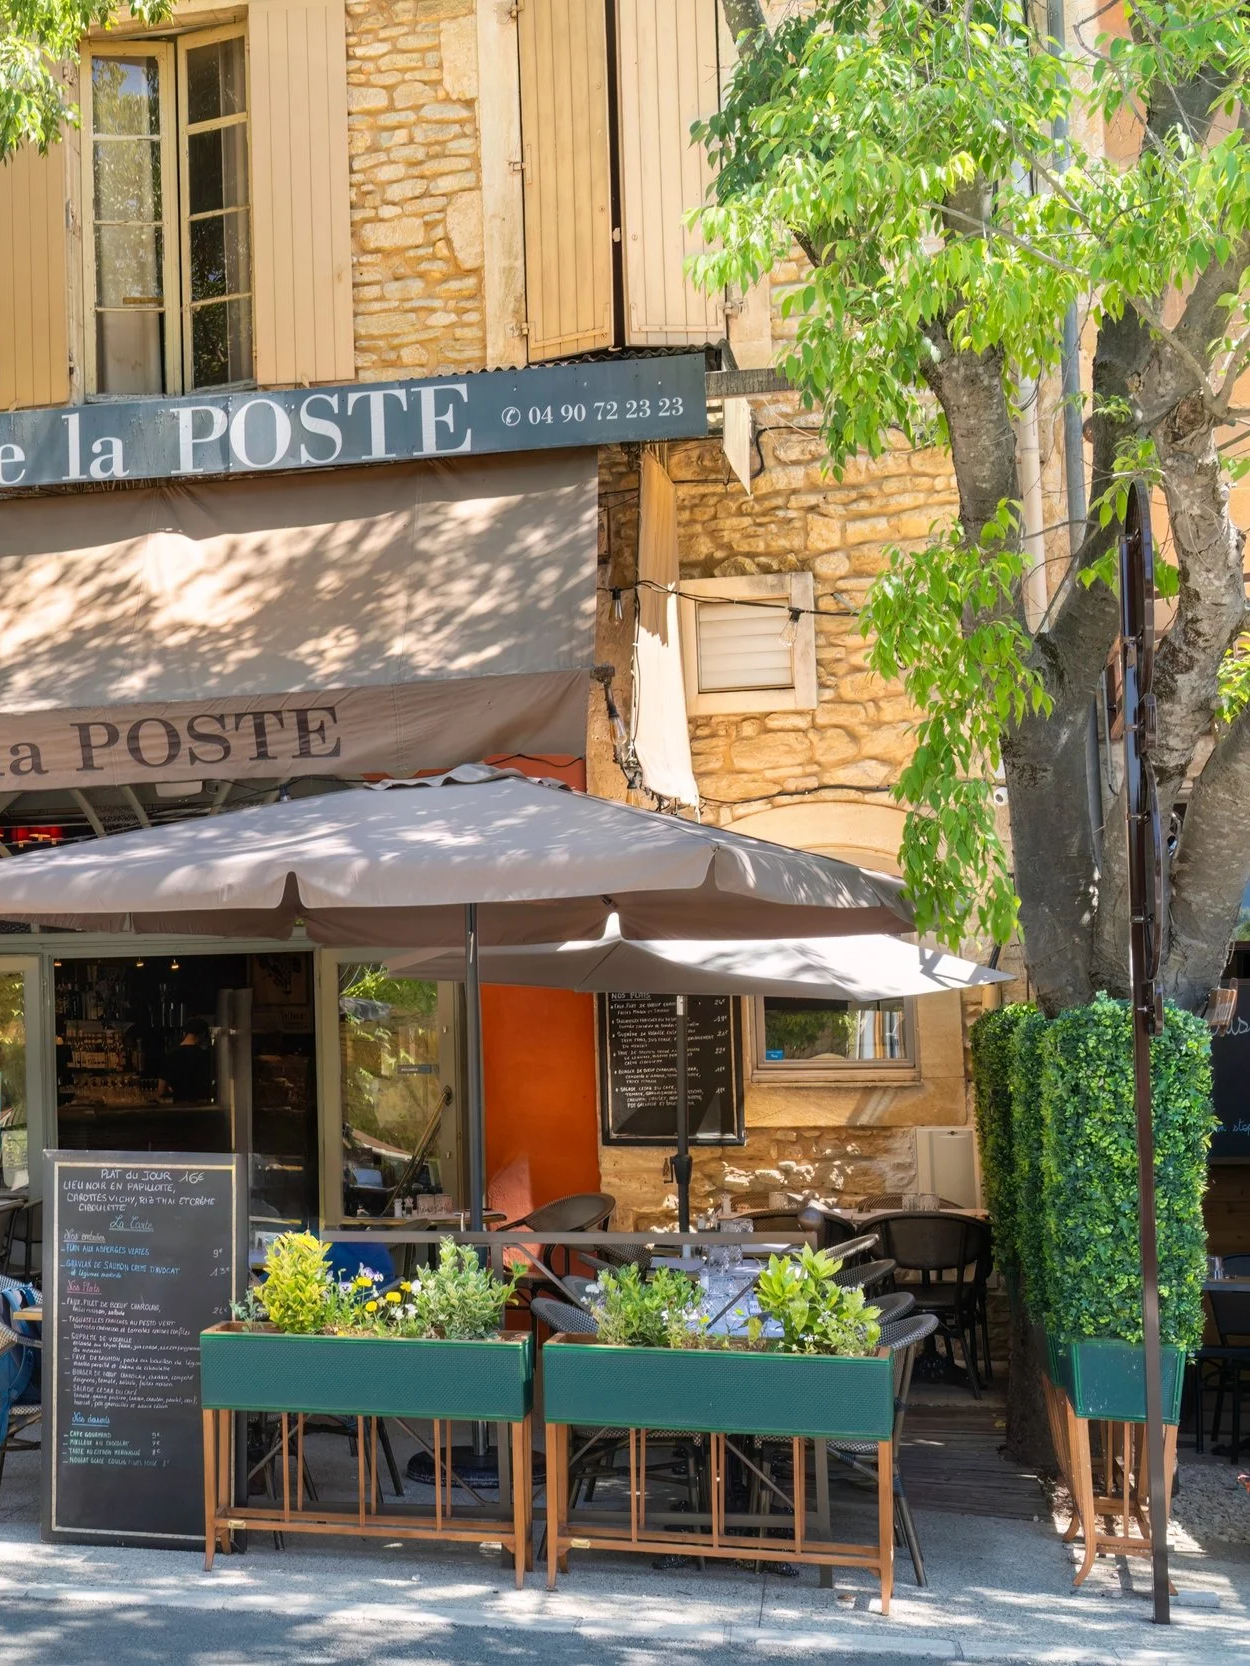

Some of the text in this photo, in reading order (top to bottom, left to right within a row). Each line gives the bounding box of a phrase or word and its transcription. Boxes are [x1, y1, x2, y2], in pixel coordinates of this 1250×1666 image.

[61, 413, 130, 481] la
[170, 382, 473, 476] POSTE
[528, 405, 554, 425] 04
[561, 403, 587, 424] 90
[593, 401, 620, 422] 72
[625, 399, 652, 420] 23
[658, 396, 685, 418] 23
[70, 706, 342, 772] POSTE
[101, 1169, 205, 1184] PLAT du JOUR 16€
[63, 1180, 83, 1190] LIEU
[85, 1181, 107, 1190] NOIR
[110, 1181, 123, 1191] EN
[67, 1192, 107, 1202] CAROTTES
[108, 1195, 138, 1207] VICHY,
[78, 1203, 126, 1212] CIBOULETTE
